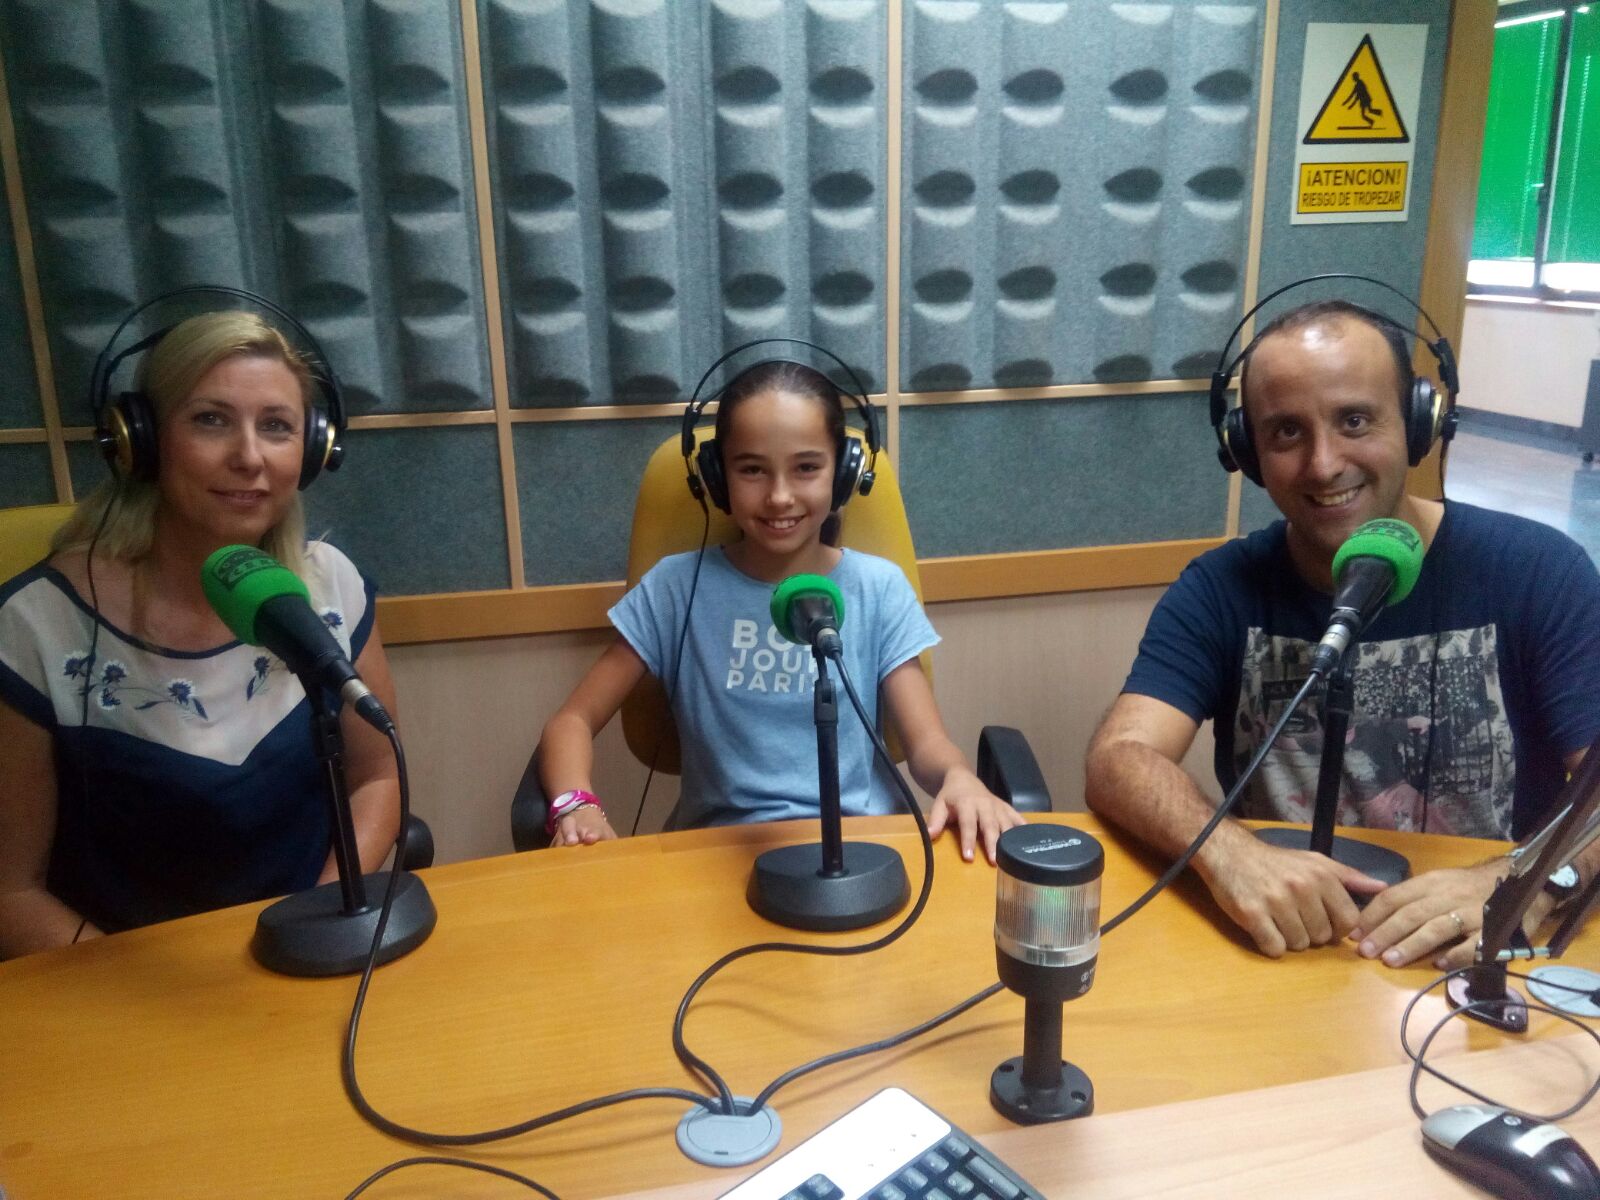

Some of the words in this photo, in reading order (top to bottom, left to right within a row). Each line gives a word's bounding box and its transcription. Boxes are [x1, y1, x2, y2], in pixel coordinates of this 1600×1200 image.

[1306, 168, 1401, 186] ¡ATENCION!
[1302, 192, 1335, 206] RIESGO
[1338, 192, 1350, 205] DE
[1353, 190, 1400, 205] TROPEZAR
[733, 619, 812, 651] BO
[727, 670, 818, 693] PARI
